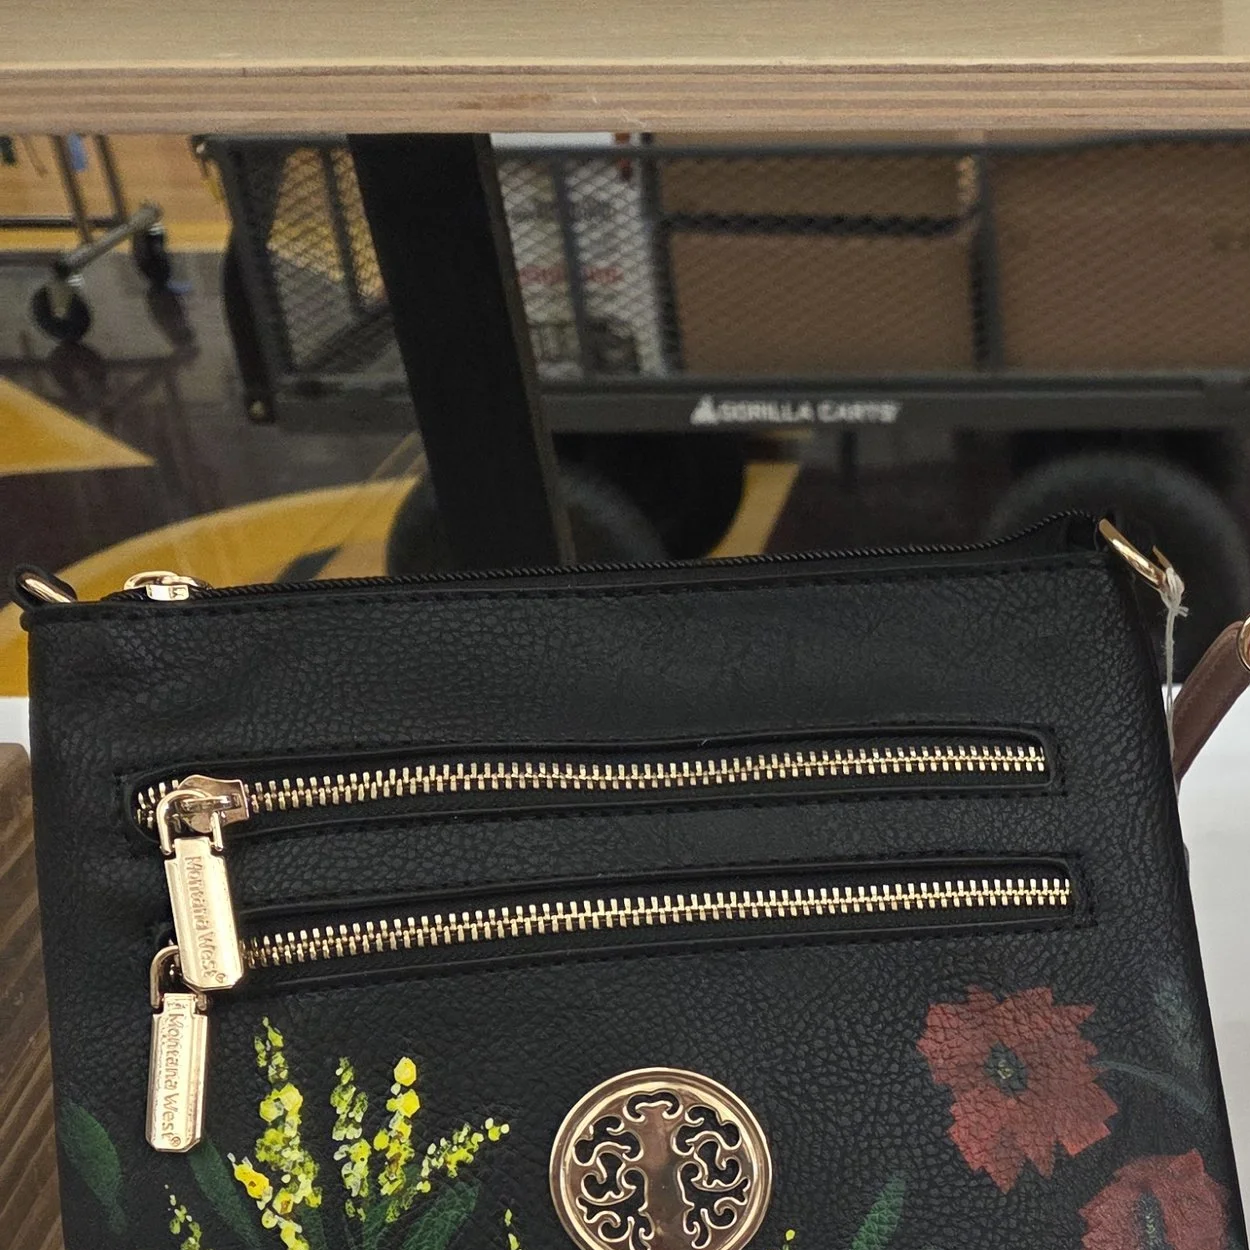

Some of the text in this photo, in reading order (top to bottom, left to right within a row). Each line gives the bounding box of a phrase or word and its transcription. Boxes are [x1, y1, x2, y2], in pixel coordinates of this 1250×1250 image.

[718, 401, 815, 423] GORILLA
[184, 856, 210, 931] Montana
[163, 1013, 185, 1091] Montana
